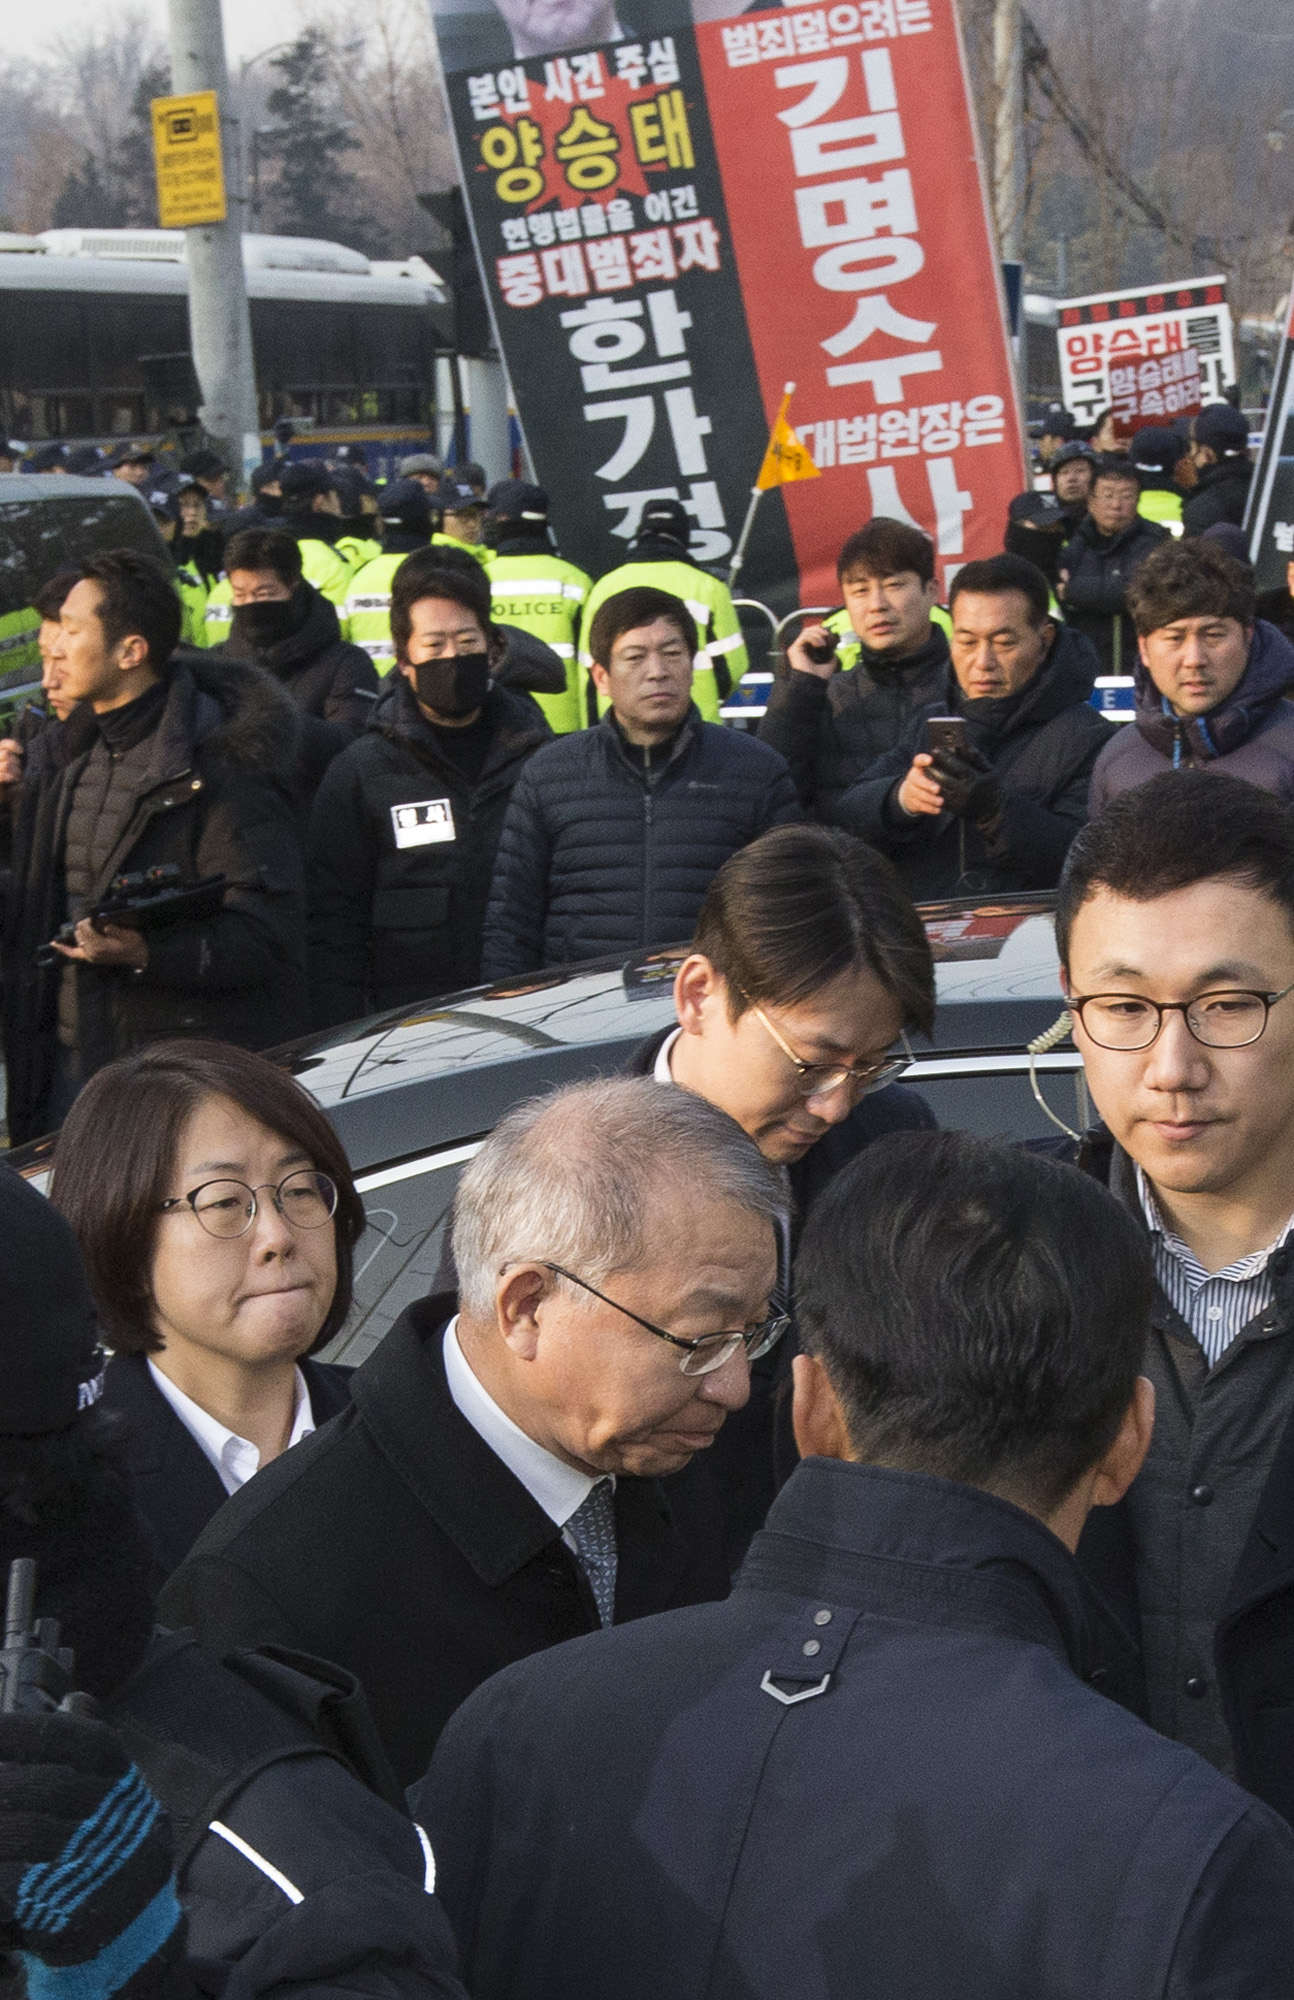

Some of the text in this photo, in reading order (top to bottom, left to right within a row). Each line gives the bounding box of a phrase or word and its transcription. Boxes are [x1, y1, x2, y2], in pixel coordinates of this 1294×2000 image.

[722, 0, 933, 68] 범죄덮으려는
[467, 37, 681, 121] 본인 사건 주심
[480, 89, 695, 203] 양승태
[501, 184, 699, 251] 현행법률을 어긴
[774, 47, 943, 405] 김명수
[496, 217, 721, 308] 중대범죄자
[795, 394, 1005, 468] 대법원장은
[490, 602, 563, 616] OLICE
